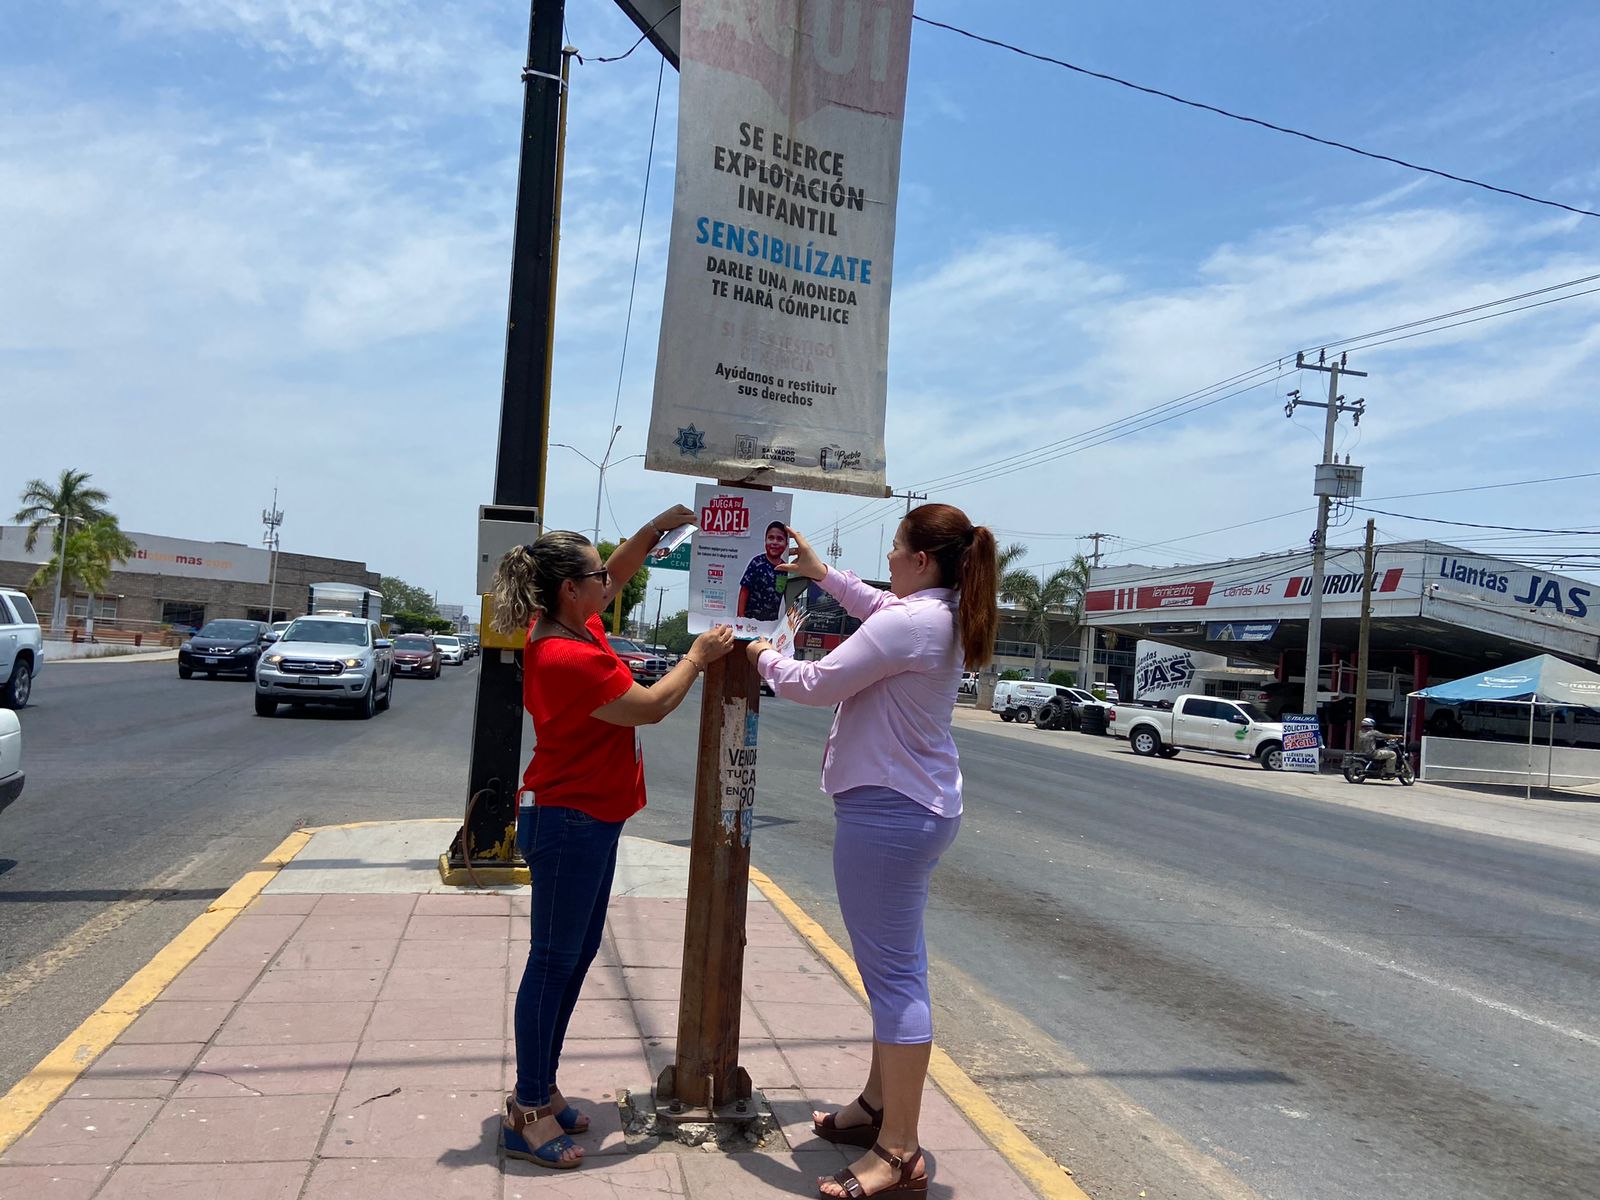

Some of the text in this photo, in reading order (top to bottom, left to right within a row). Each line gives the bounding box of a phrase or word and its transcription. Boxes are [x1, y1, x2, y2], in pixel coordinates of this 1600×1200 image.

[739, 122, 845, 177] SE EJERCE
[713, 145, 865, 211] EXPLOTACIÓN
[738, 184, 838, 237] INFANTIL
[695, 216, 873, 285] SENSIBILÍZATE
[706, 255, 857, 306] DARLE UNA MONEDA
[712, 279, 850, 325] TE HARÁ CÓMPLICE
[715, 362, 837, 396] Ayúdanos a restituir
[737, 384, 814, 407] sus derechos
[761, 447, 796, 457] SALVADOR
[761, 454, 796, 463] ALVARADO
[711, 499, 733, 509] JUEGA
[704, 509, 747, 531] PAPEL
[1253, 583, 1273, 596] JAS
[1300, 571, 1379, 597] UIROYL
[1440, 556, 1591, 618] Llantas JAS
[1138, 659, 1187, 692] JAS
[1283, 725, 1309, 733] SOLICITA
[727, 769, 742, 779] TU
[725, 786, 755, 807] EN 90
